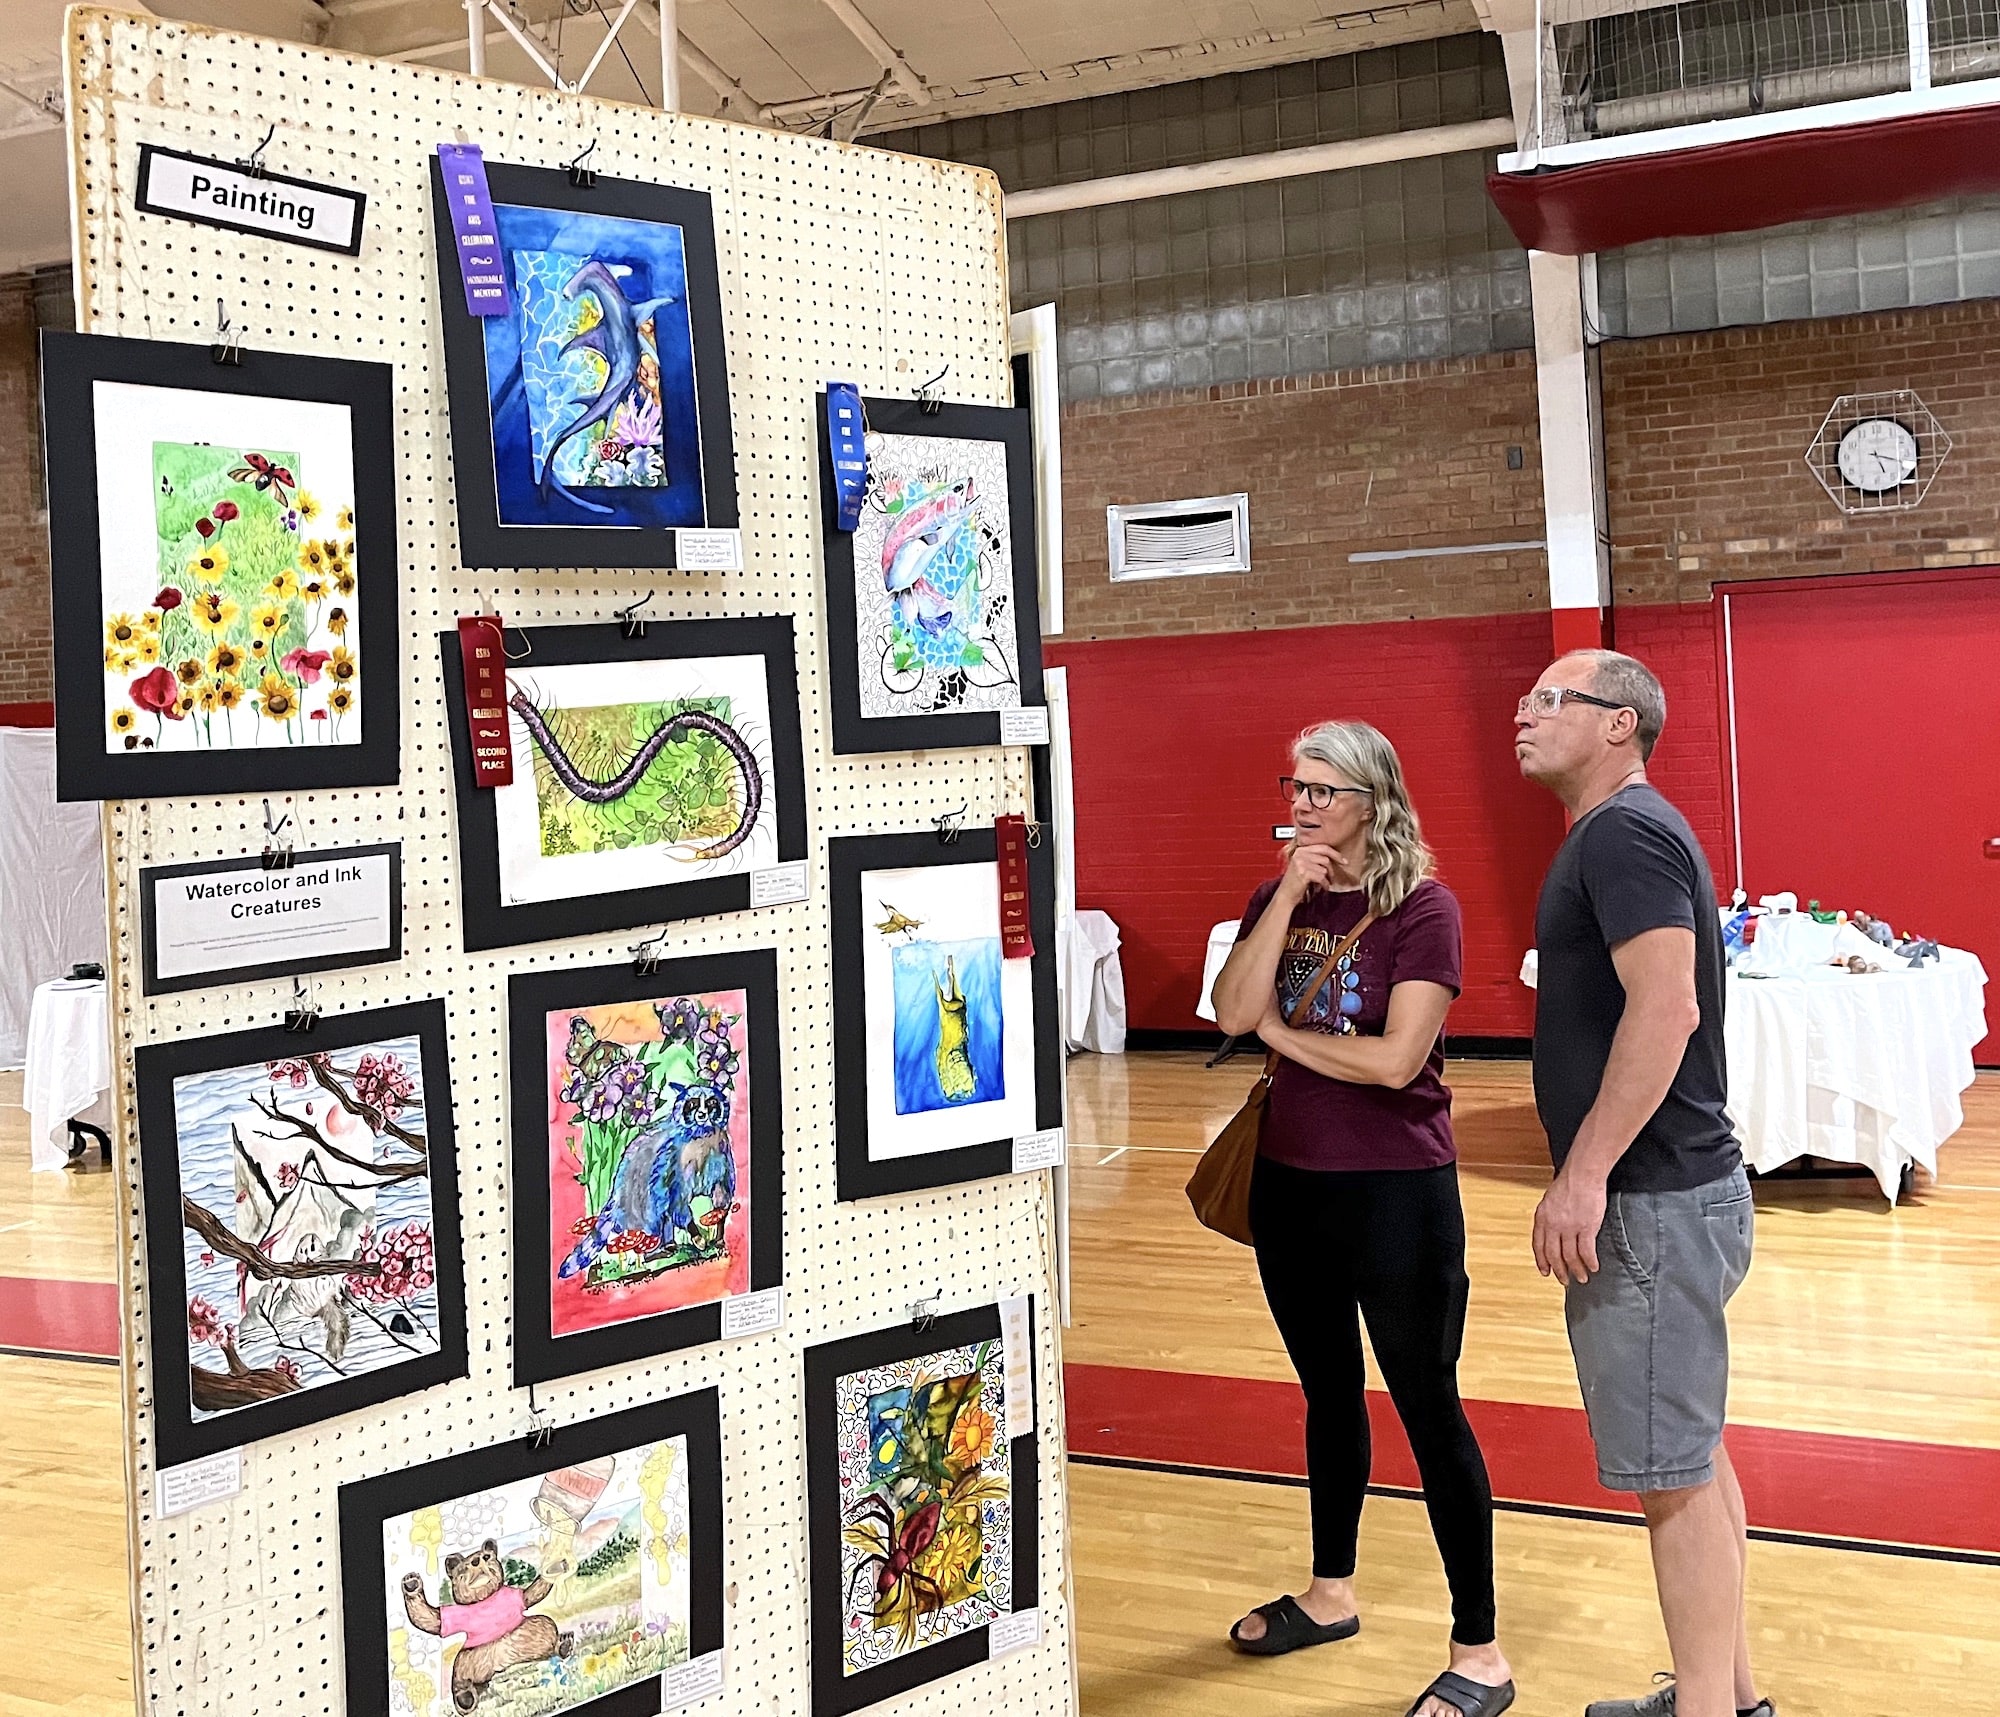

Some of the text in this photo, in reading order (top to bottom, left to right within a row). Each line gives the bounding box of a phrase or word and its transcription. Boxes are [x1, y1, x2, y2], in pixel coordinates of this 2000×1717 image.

[191, 174, 315, 230] Painting
[472, 288, 502, 298] MENTION
[476, 747, 508, 757] SECOND
[481, 760, 506, 770] PLACE
[185, 866, 362, 900] Watercolor and Ink
[230, 896, 322, 919] Creatures
[1006, 935, 1026, 944] PLACE
